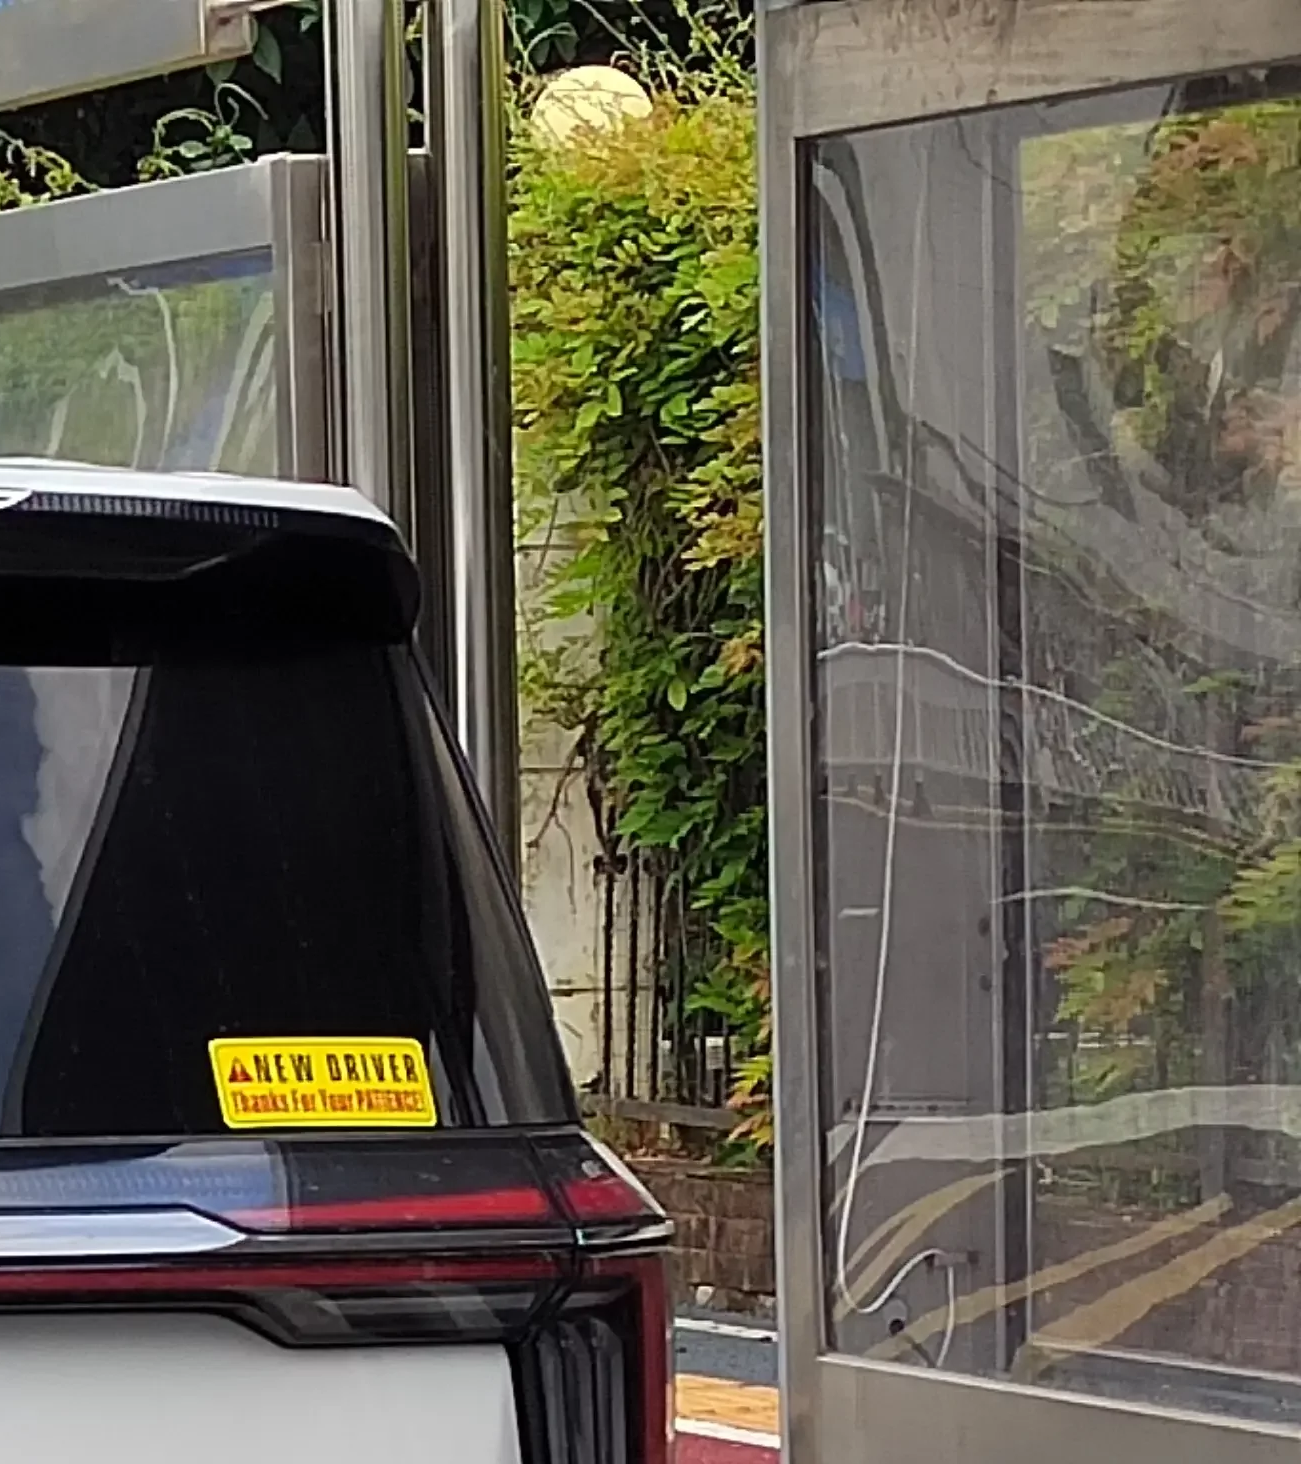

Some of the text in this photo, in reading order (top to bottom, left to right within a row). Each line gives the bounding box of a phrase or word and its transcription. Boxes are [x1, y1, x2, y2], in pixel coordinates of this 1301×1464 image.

[254, 1053, 419, 1083] NEW DRIVER
[231, 1089, 289, 1113] Thanks
[291, 1089, 316, 1113] For
[318, 1089, 354, 1113] Your
